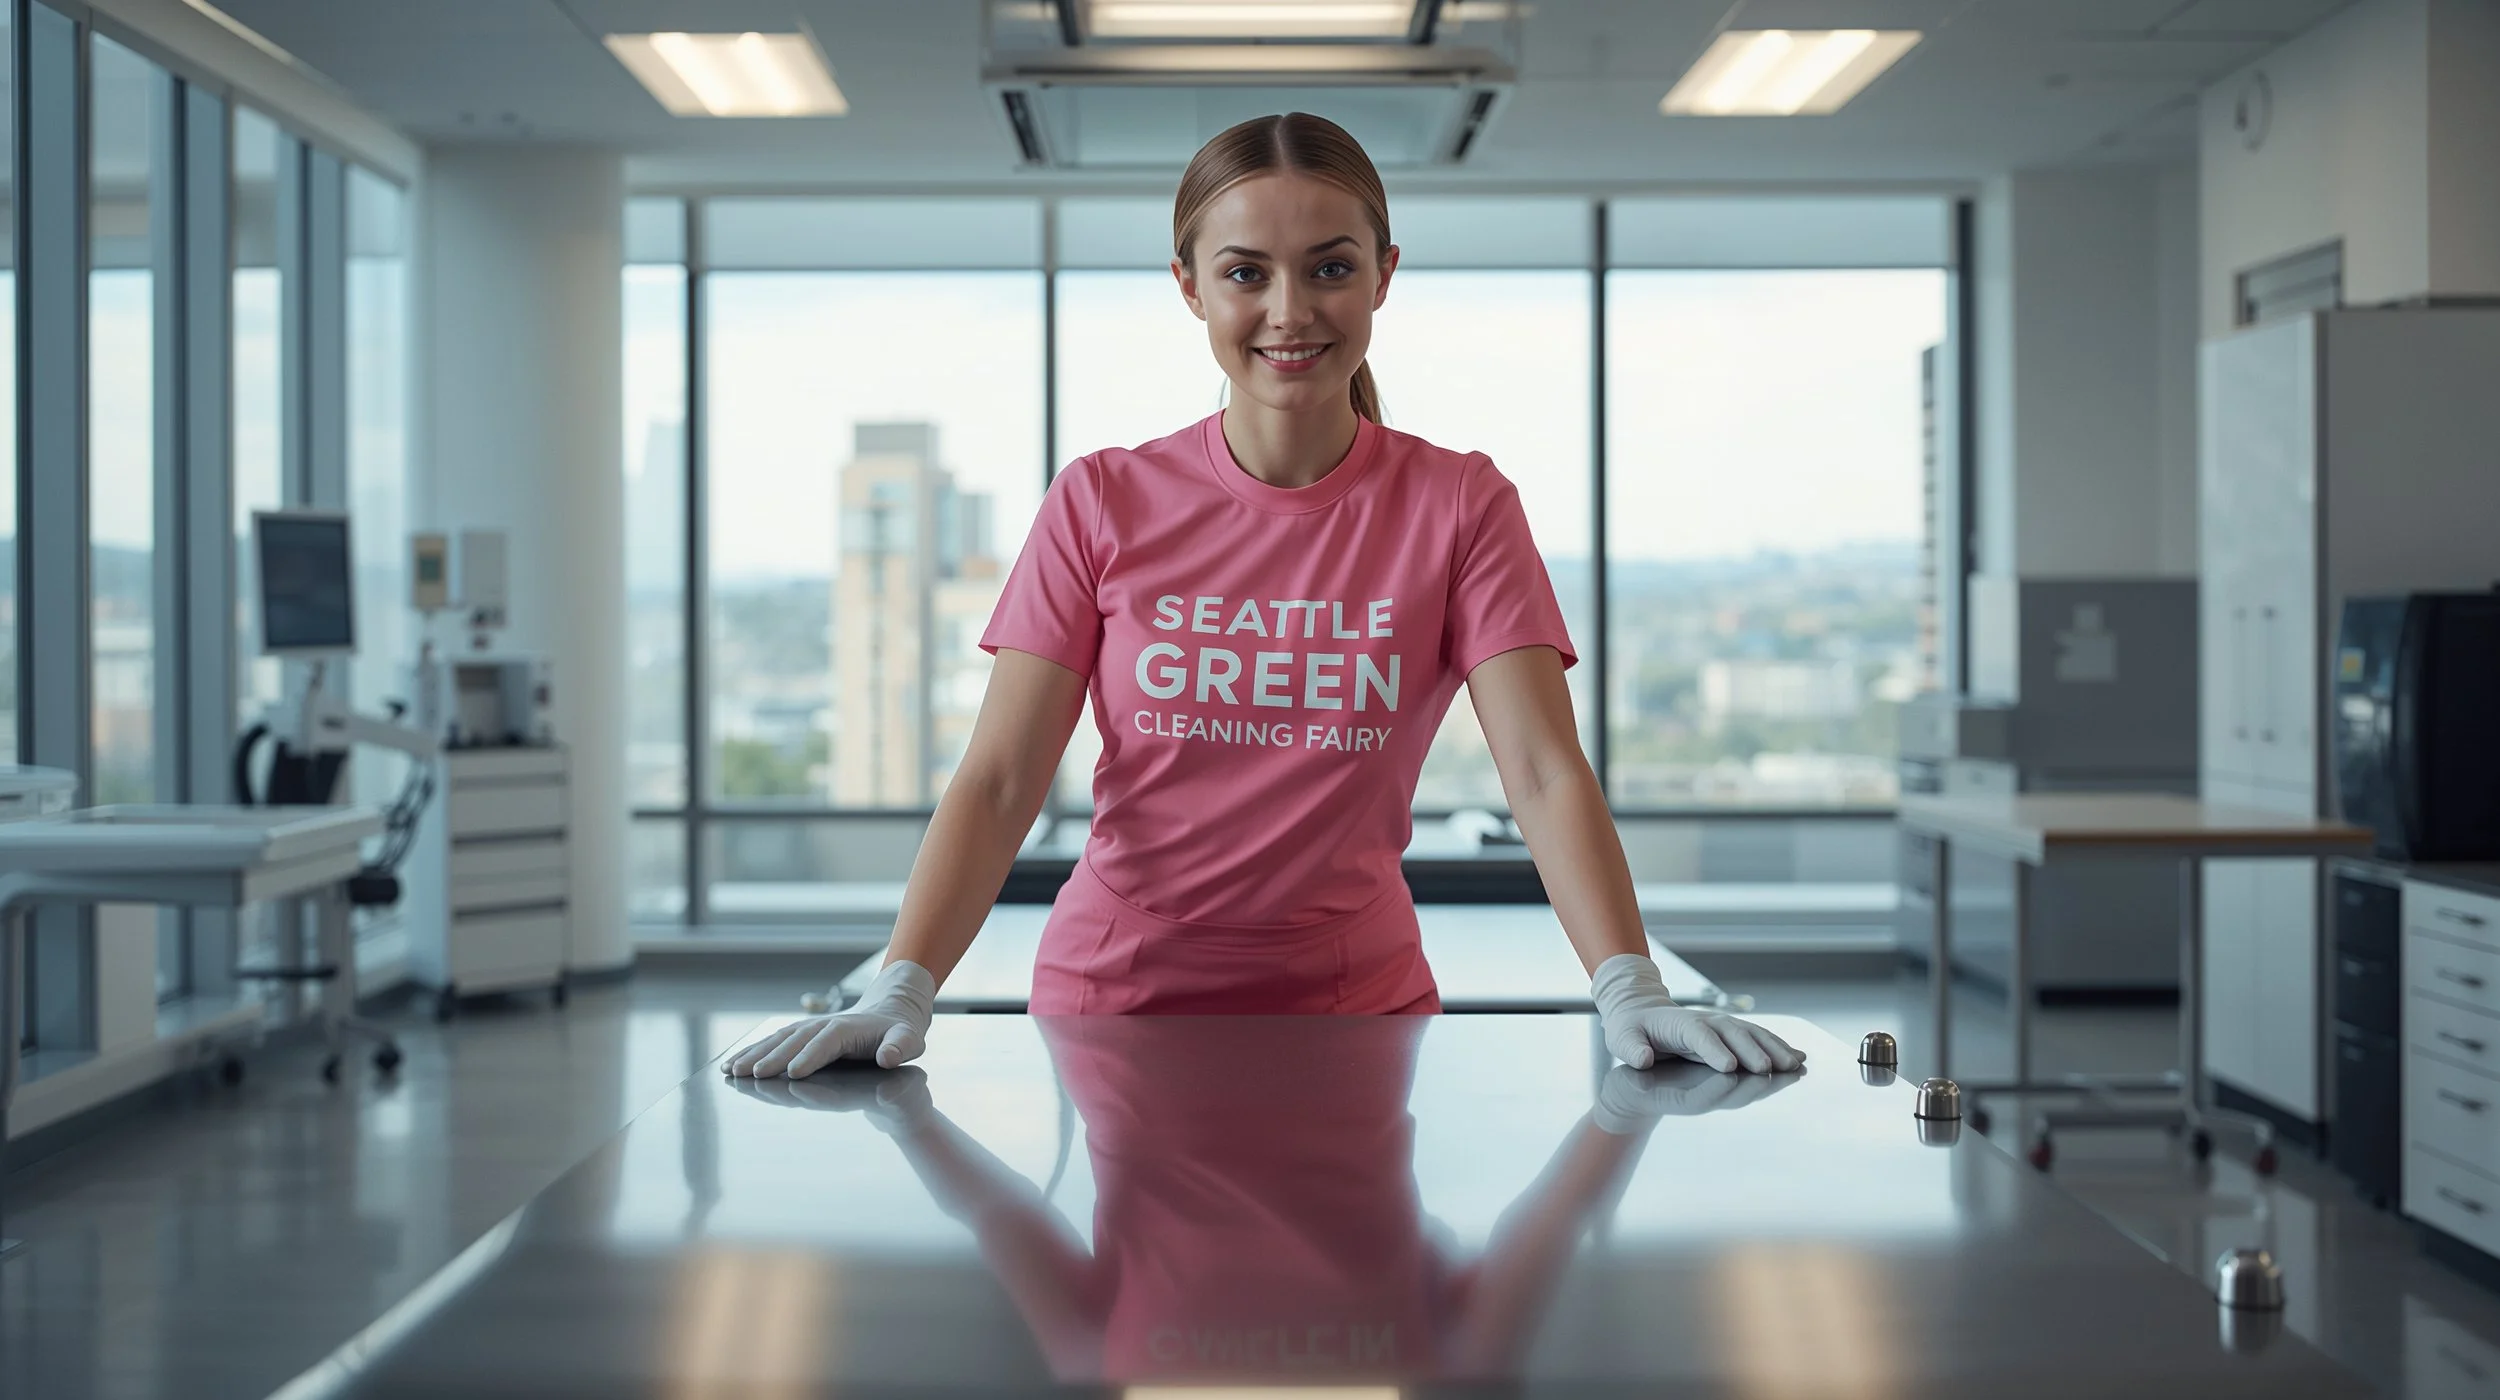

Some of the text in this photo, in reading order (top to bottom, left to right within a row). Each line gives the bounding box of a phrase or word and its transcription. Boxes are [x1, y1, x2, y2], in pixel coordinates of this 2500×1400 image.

[1152, 594, 1393, 639] SEATTLE
[1135, 642, 1401, 712] GREEN
[1134, 710, 1393, 751] CLEANING FAIRY
